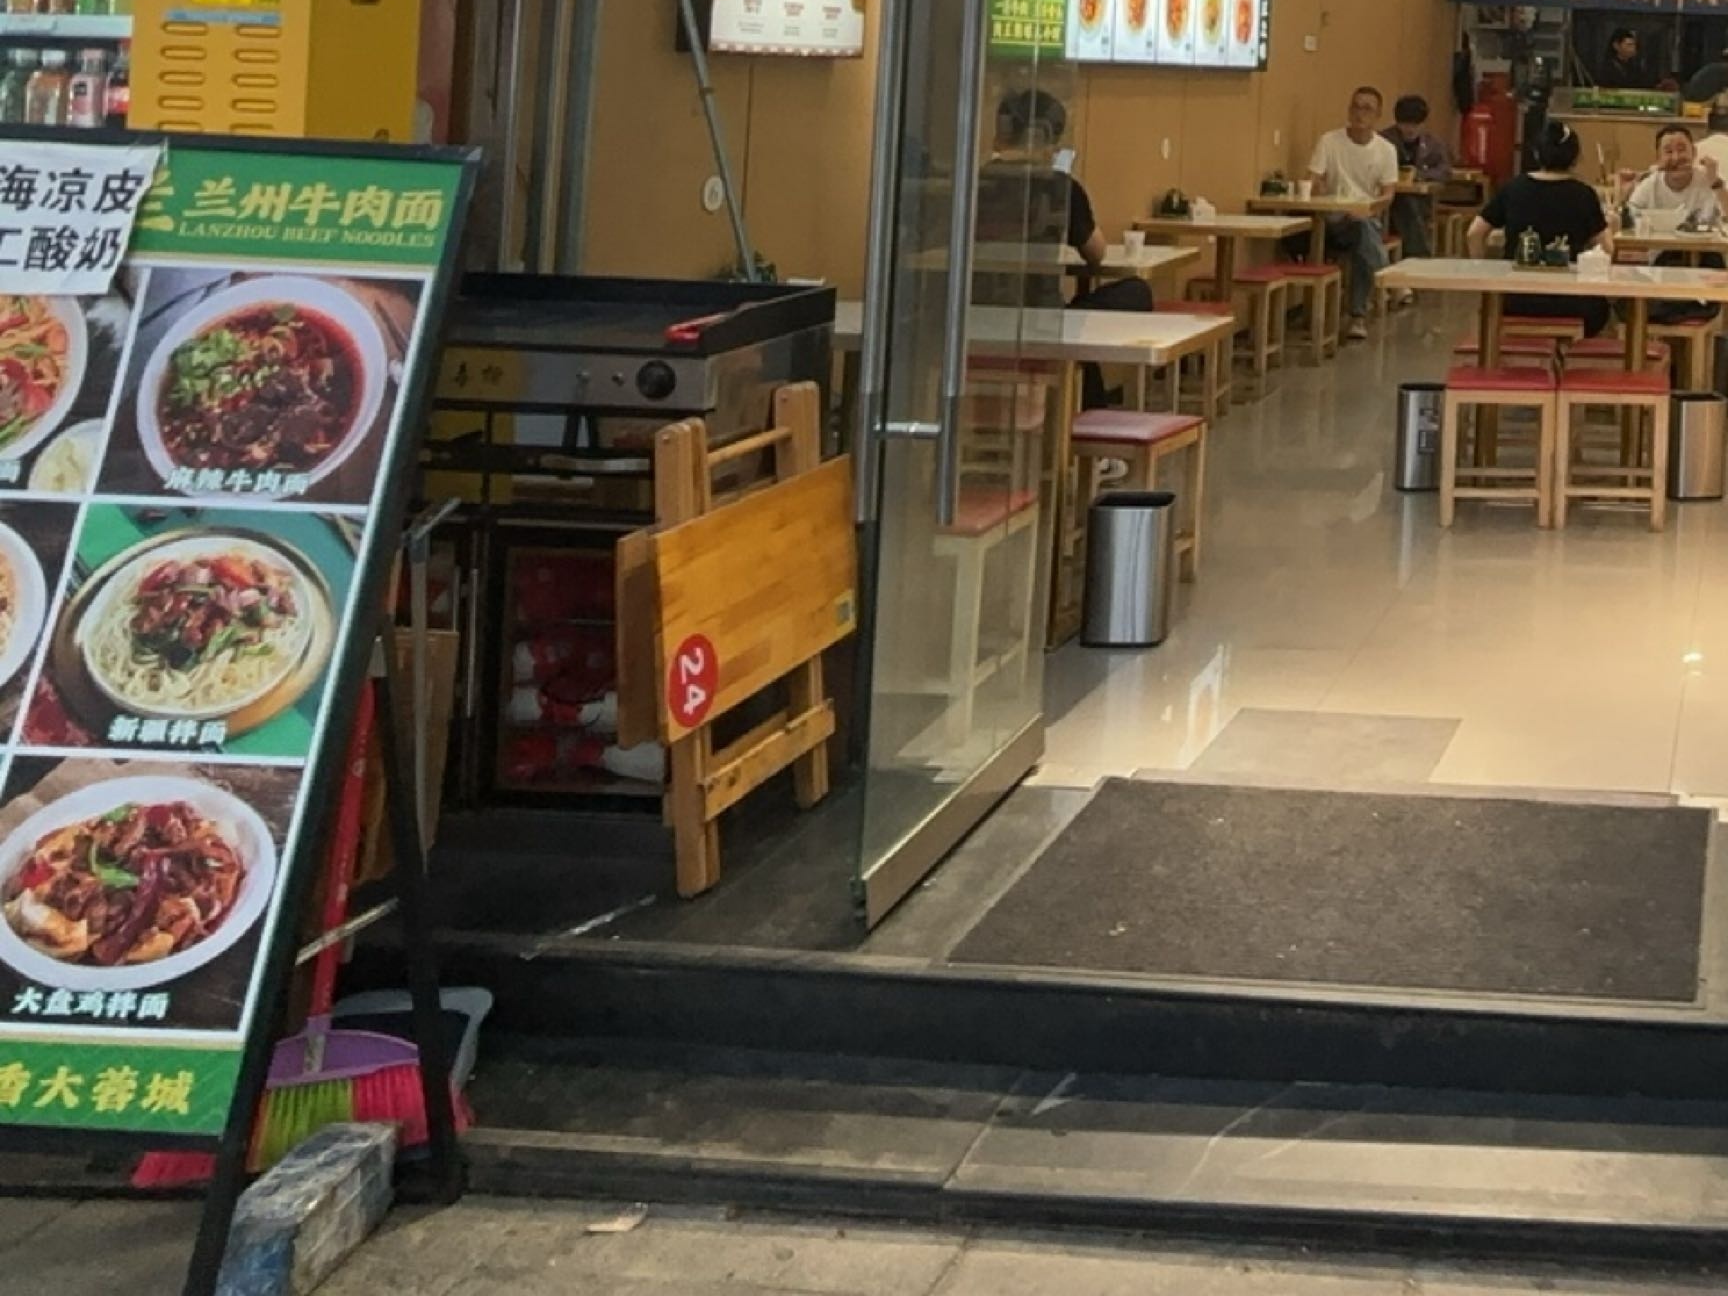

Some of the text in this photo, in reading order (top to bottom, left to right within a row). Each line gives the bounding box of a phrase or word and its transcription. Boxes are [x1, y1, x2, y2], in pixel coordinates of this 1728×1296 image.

[0, 165, 145, 214] 海凉皮
[181, 175, 443, 230] 兰州牛肉面
[178, 221, 437, 248] LANZHOU BEEF NOODLES
[677, 646, 707, 715] 24
[10, 985, 170, 1020] 大盘鸡拌面
